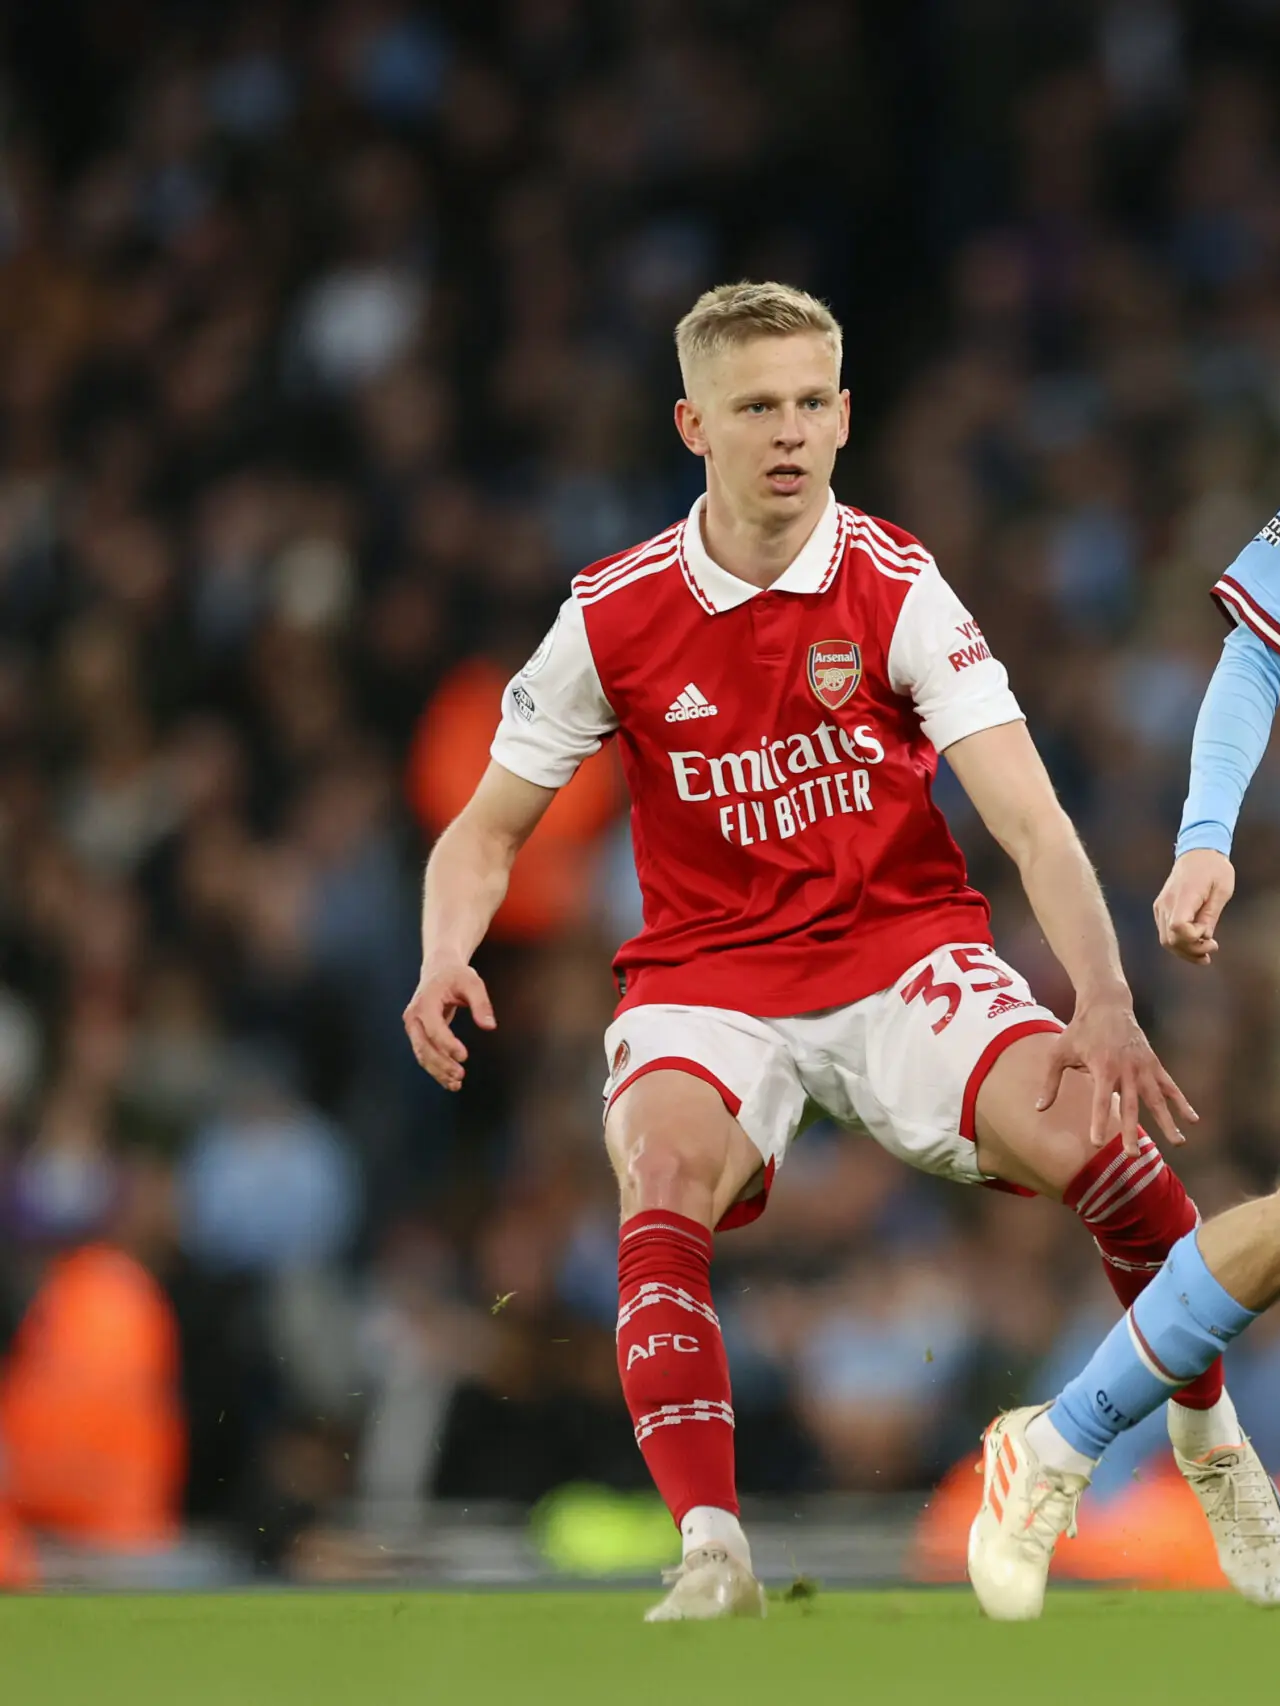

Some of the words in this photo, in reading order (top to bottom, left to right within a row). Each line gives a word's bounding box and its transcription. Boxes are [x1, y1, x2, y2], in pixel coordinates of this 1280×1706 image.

[815, 651, 854, 663] Arsenal
[664, 704, 719, 723] adidas
[667, 720, 885, 802] Emirates
[719, 800, 768, 846] FLY
[773, 768, 874, 840] BETTER
[900, 947, 1014, 1036] 35
[987, 1000, 1035, 1019] adidas
[626, 1332, 700, 1371] AFC
